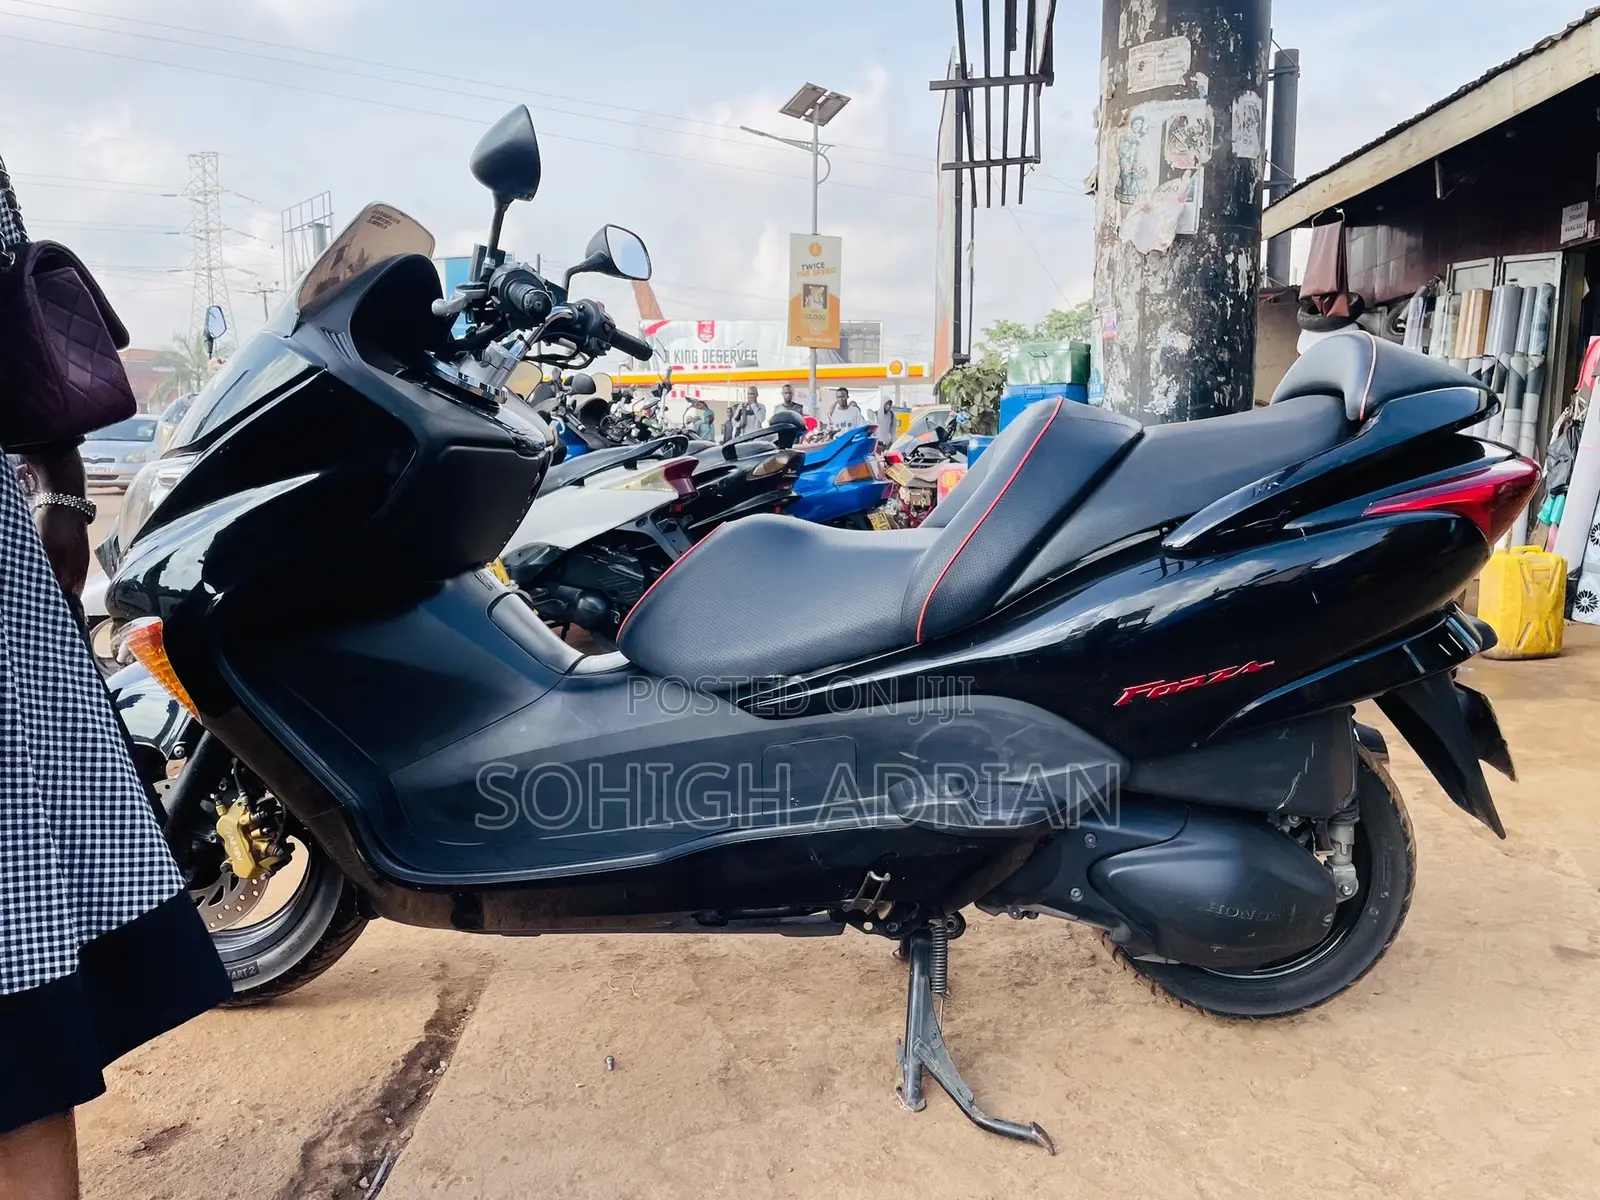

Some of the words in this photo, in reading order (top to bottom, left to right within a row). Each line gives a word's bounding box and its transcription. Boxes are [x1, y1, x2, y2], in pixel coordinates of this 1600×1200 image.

[801, 262, 825, 271] TWICE
[674, 350, 698, 364] KING
[702, 349, 758, 364] DESERVES
[248, 965, 257, 975] 2
